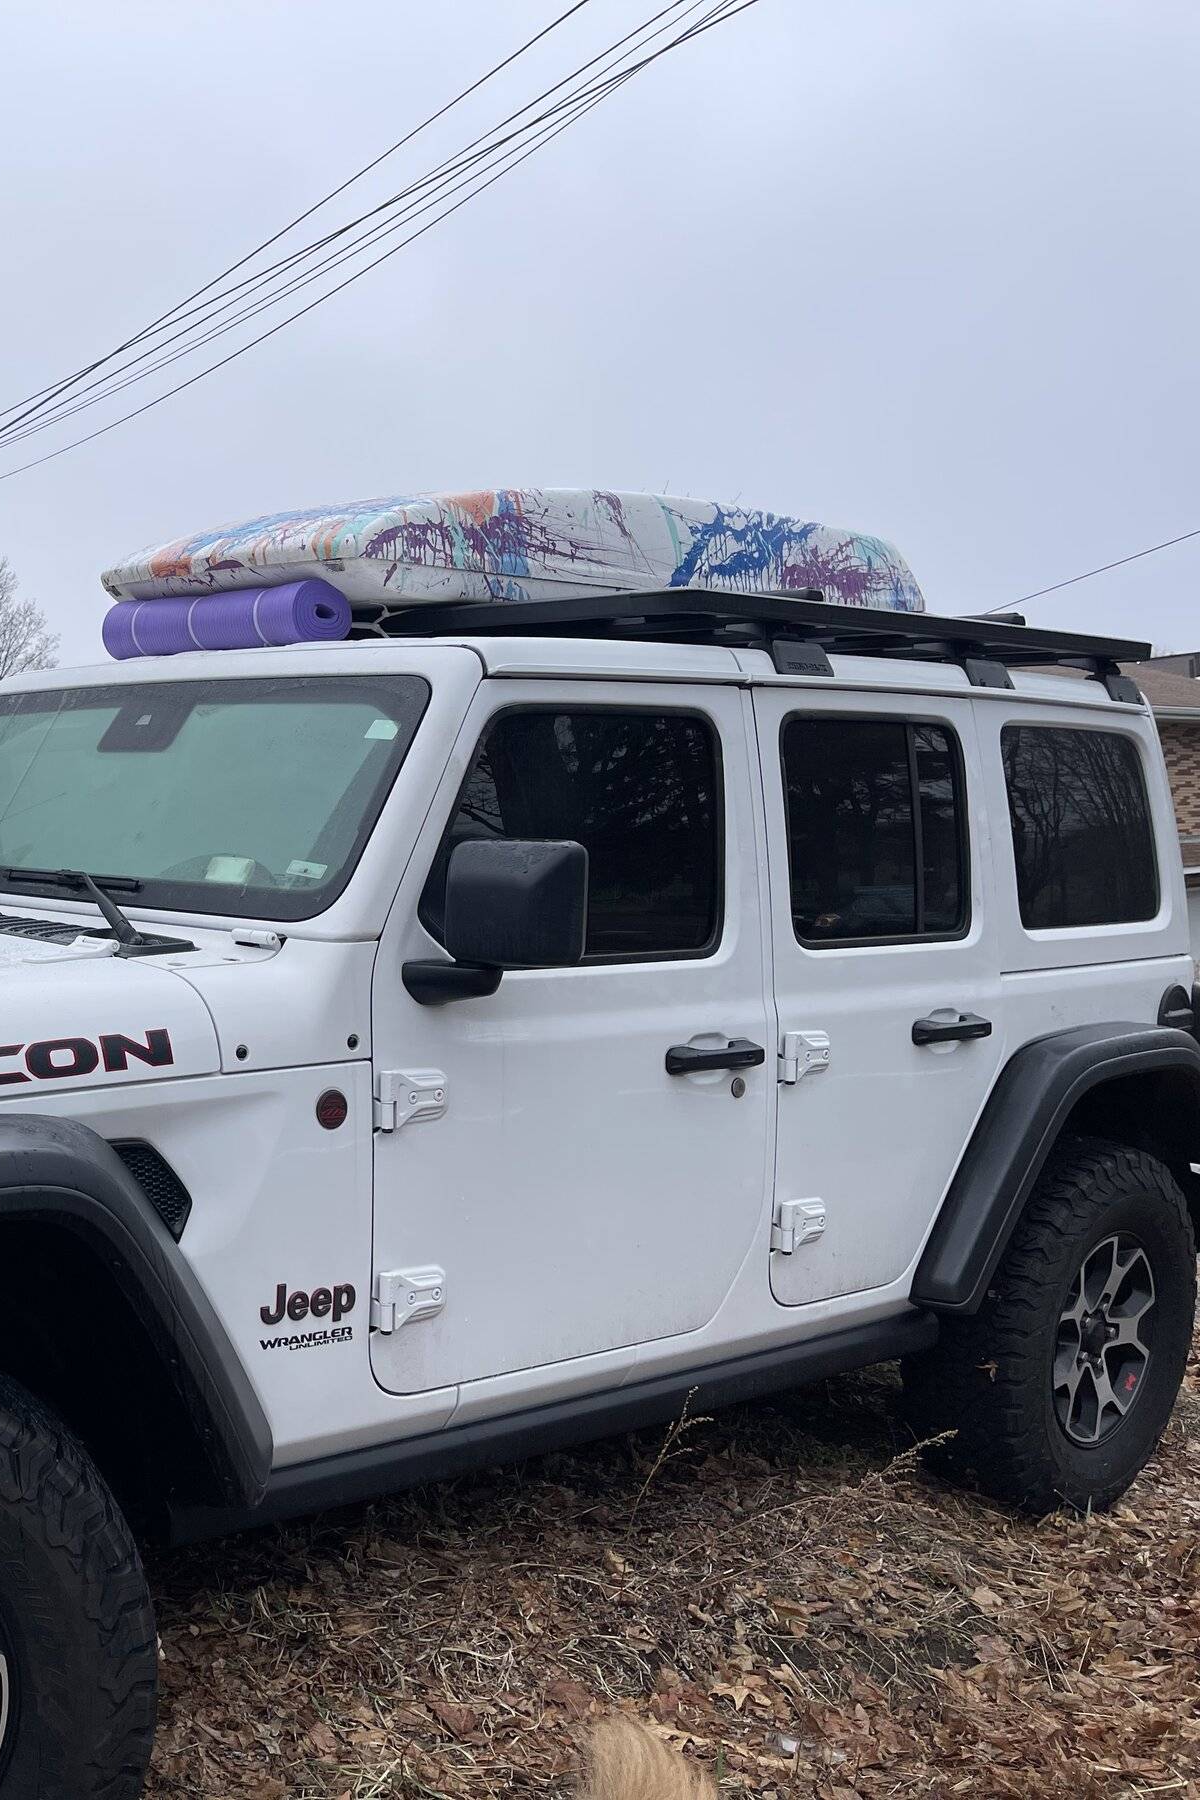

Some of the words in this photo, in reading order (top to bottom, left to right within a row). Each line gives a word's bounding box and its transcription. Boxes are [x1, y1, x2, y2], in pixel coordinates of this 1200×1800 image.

[260, 1283, 356, 1325] Jeep
[260, 1326, 352, 1350] WRANGLER
[289, 1335, 353, 1351] UNLIMITED
